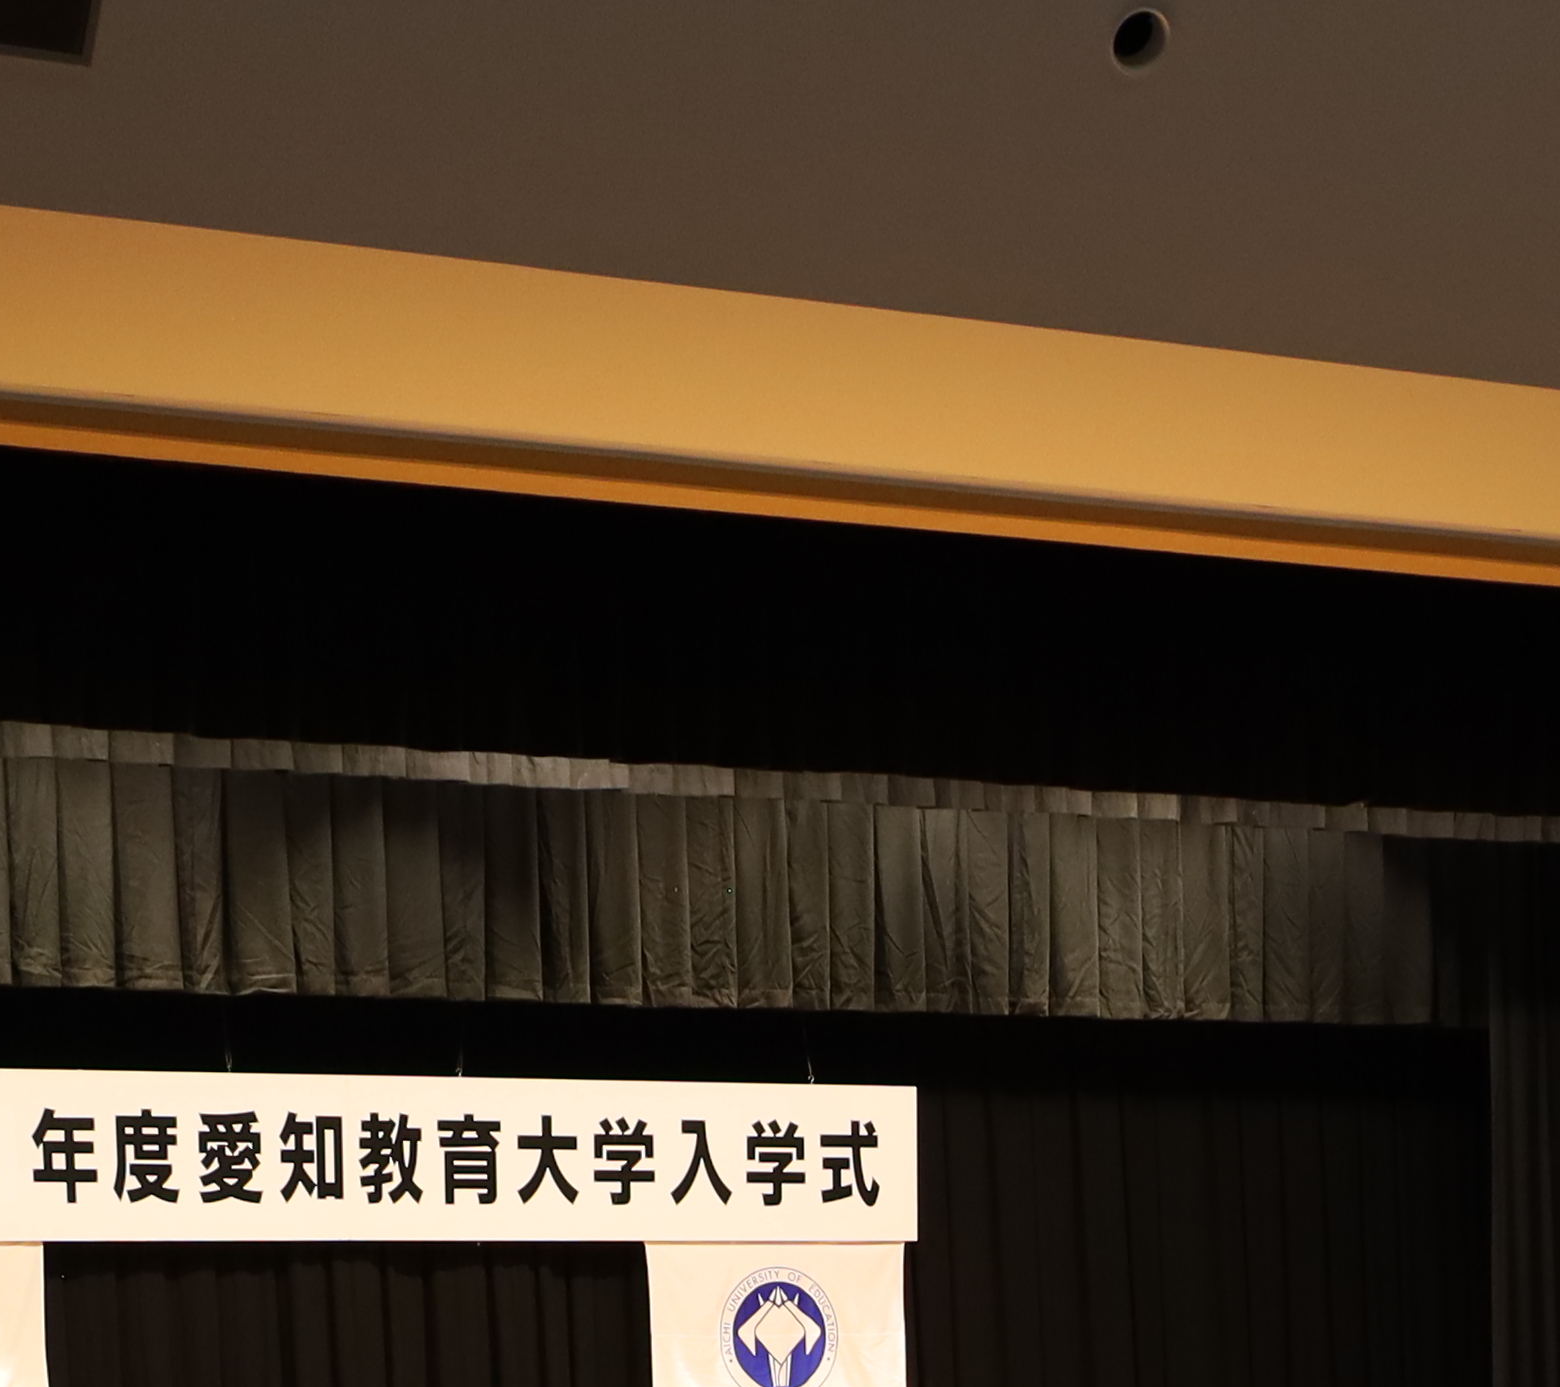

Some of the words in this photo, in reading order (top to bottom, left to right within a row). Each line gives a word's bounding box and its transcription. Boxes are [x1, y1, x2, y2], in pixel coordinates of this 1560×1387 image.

[728, 1270, 780, 1312] UNIVERSITY
[788, 1272, 803, 1284] OF
[808, 1285, 836, 1353] EDUCATION
[723, 1322, 734, 1356] AICHI
